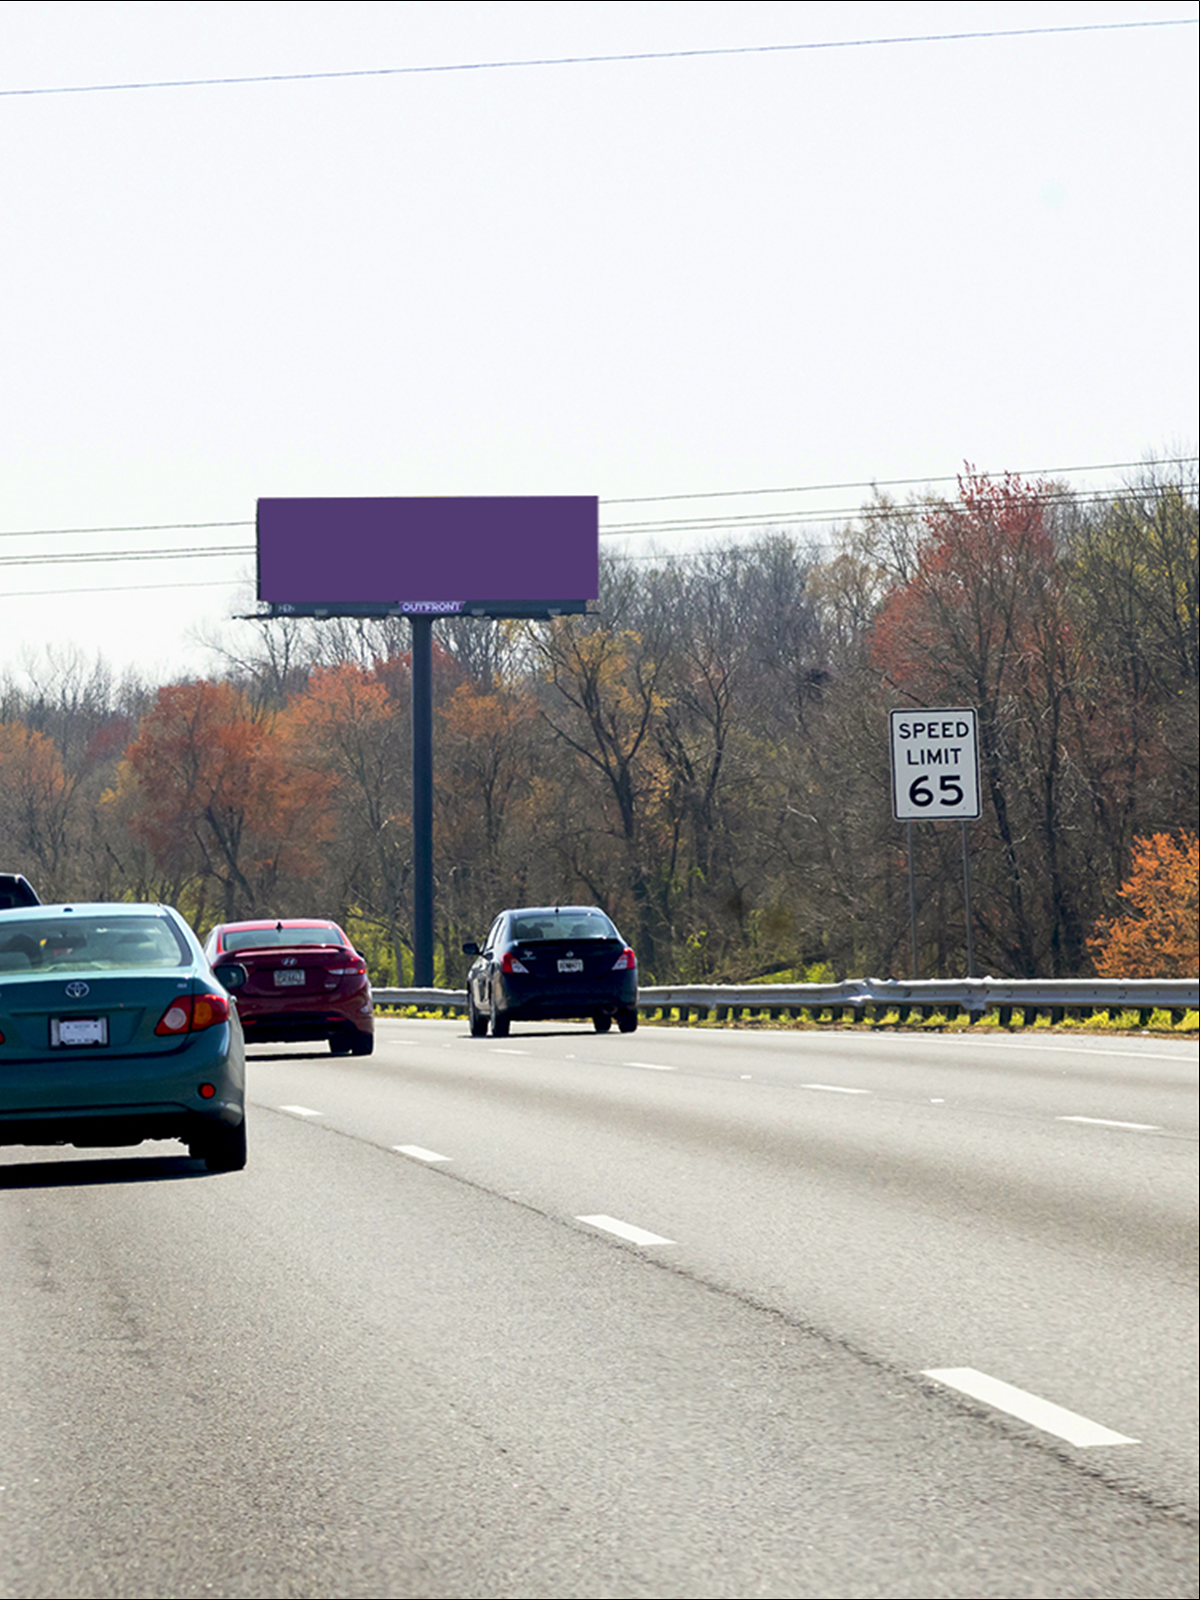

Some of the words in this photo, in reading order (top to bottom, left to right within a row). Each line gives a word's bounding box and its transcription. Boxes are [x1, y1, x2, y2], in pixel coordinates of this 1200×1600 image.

[402, 601, 462, 612] OUTFRONT
[899, 722, 969, 739] SPEED
[907, 748, 961, 765] LIMIT
[909, 775, 963, 807] 65
